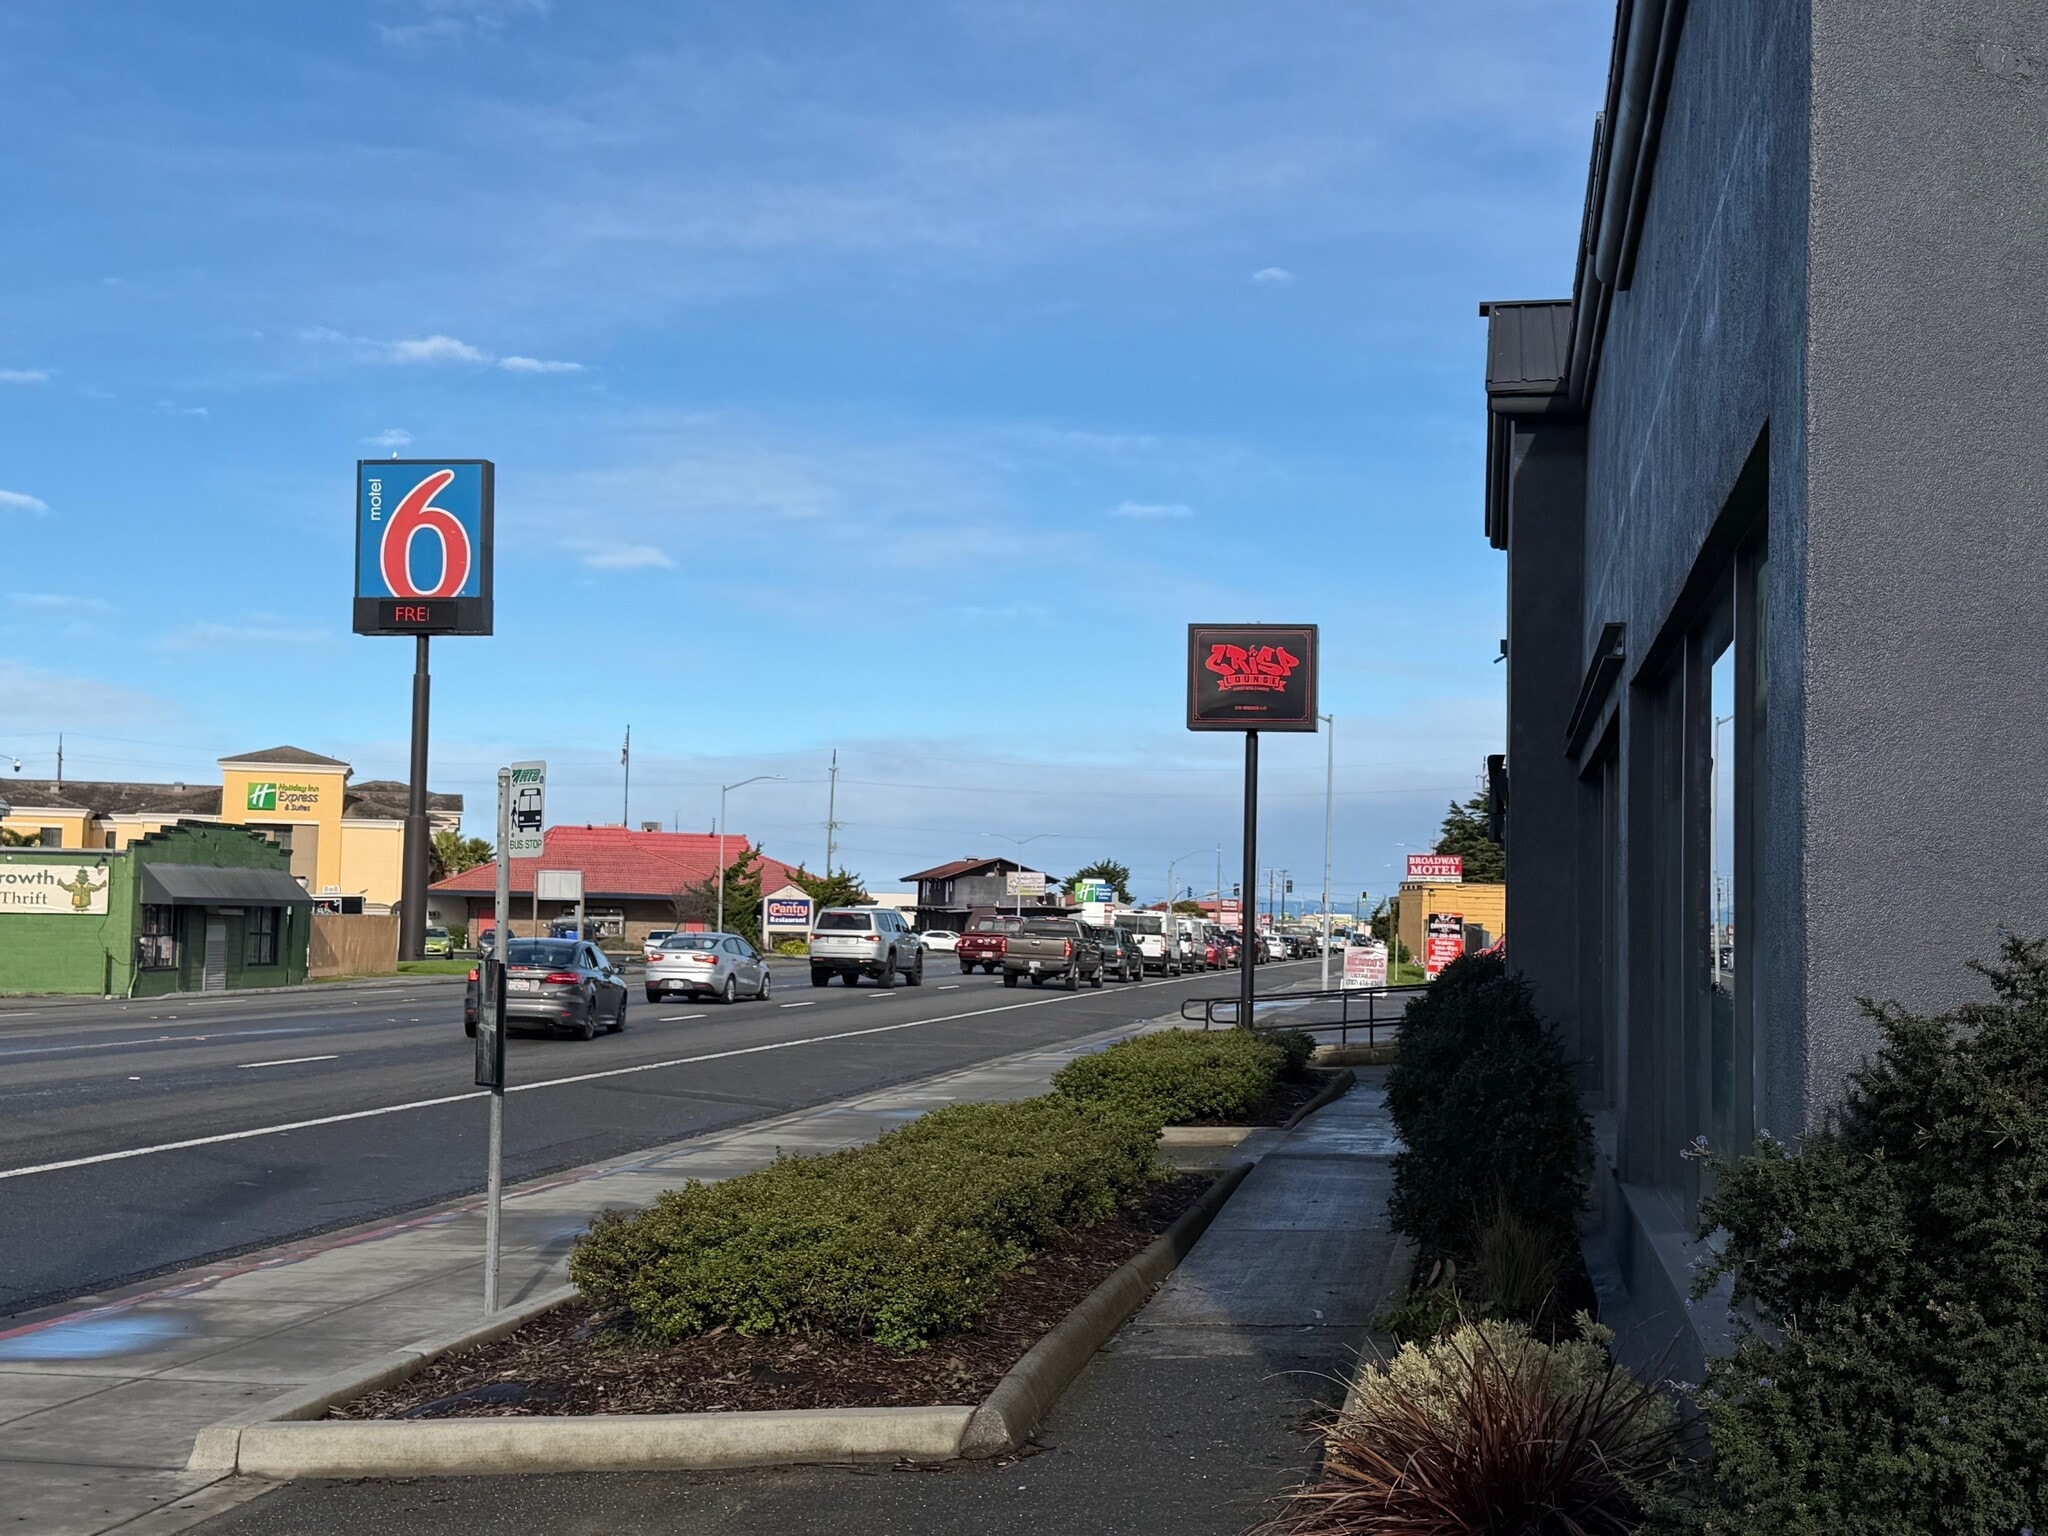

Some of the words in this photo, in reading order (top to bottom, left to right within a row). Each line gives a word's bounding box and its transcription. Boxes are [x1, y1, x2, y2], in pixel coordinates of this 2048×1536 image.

[368, 478, 382, 521] motel
[380, 468, 471, 598] 6
[1226, 676, 1279, 686] LOUNGE
[278, 783, 307, 793] Holiday
[308, 784, 320, 792] Inn
[278, 792, 319, 803] Express
[290, 804, 311, 812] Suites
[510, 840, 524, 850] BUS
[525, 839, 543, 850] STOP
[1409, 856, 1461, 865] BROADWAY
[1410, 865, 1460, 875] MOTEL
[0, 891, 48, 905] Thrift
[769, 903, 808, 917] Pantry
[769, 916, 807, 924] Restaurant
